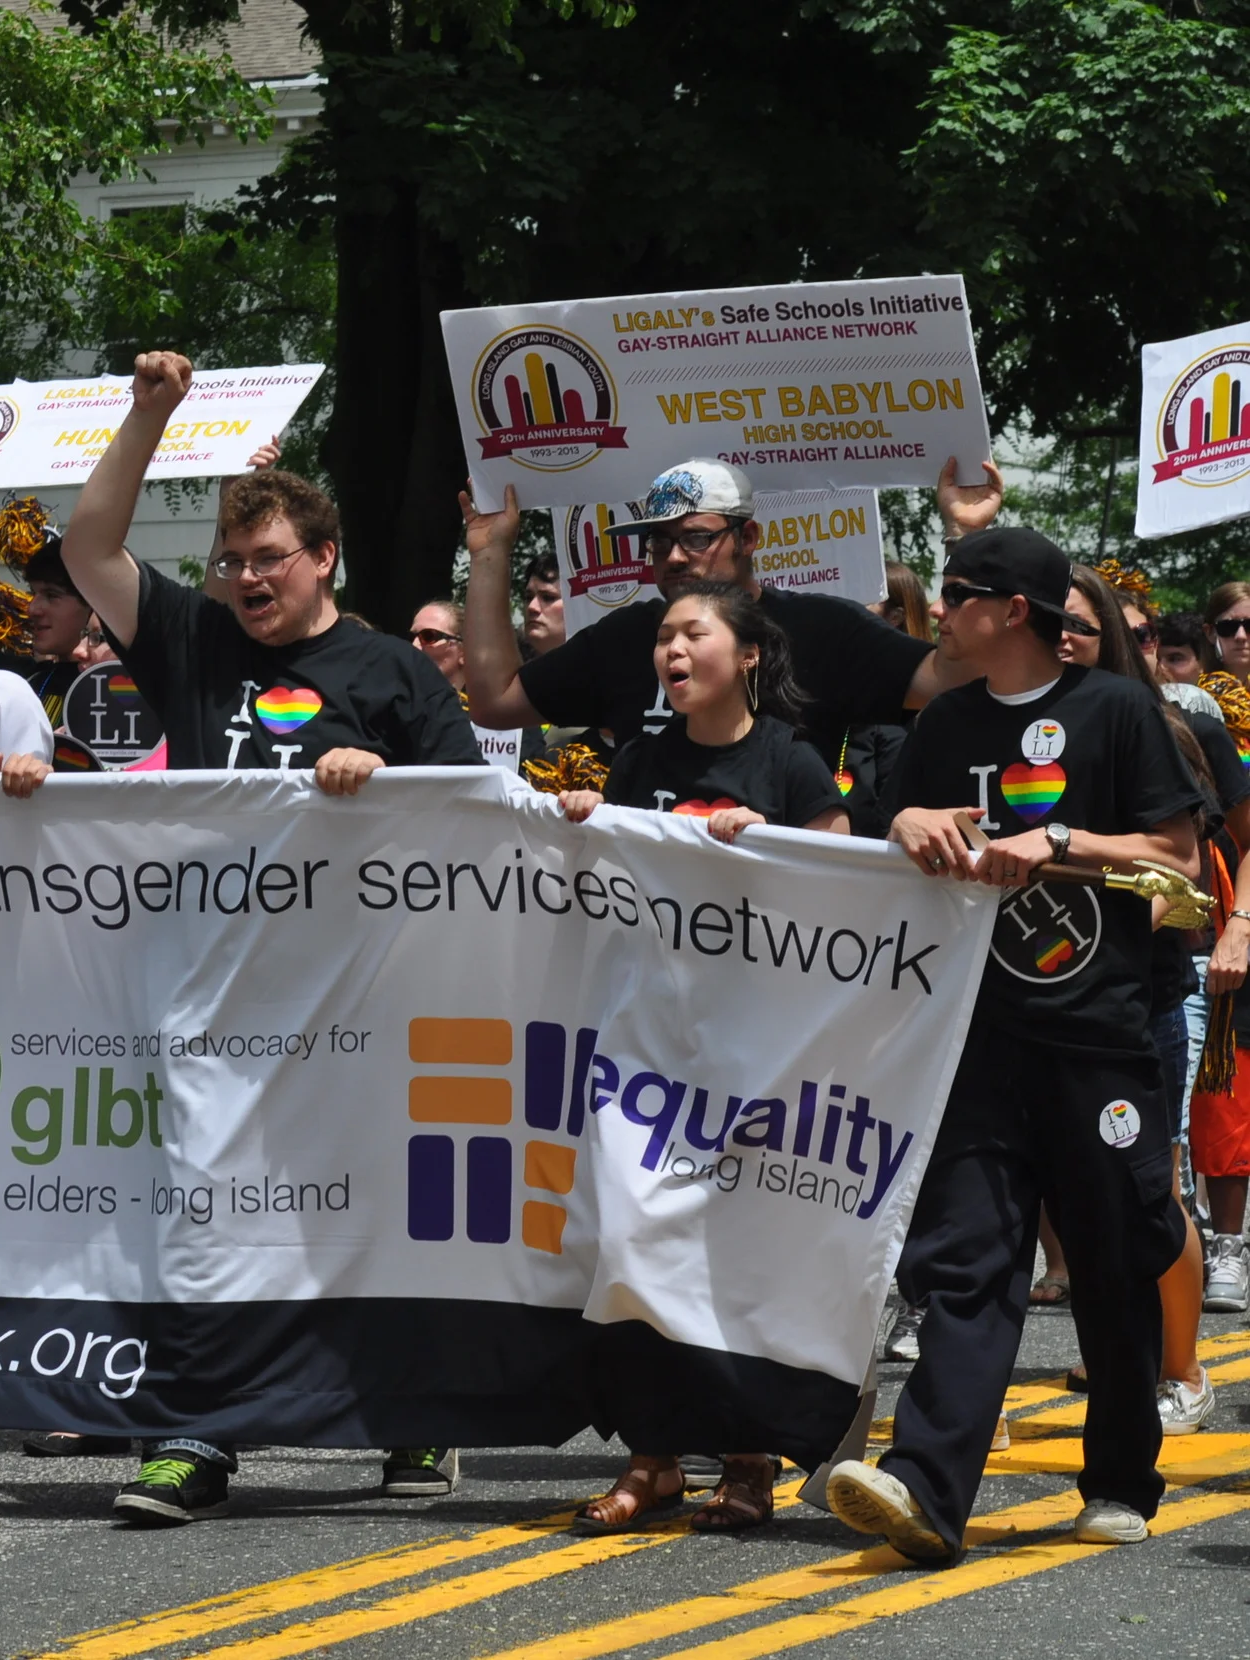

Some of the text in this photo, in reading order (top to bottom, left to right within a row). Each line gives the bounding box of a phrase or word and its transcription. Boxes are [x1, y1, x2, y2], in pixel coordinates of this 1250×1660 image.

[613, 293, 964, 333] LIGALY's Safe Schools Initiative
[618, 321, 918, 354] GAY-STRAIGHT ALLIANCE NETWORK
[482, 334, 605, 400] LONG ISLAND GAY AND LESBIAN YOUTH
[37, 397, 130, 411] GAY-STRAIGHT
[196, 389, 266, 401] NETWORK
[44, 385, 121, 400] LIGALY's
[190, 379, 234, 390] hools
[239, 373, 314, 387] Initiative
[1166, 397, 1182, 426] LONG
[1177, 366, 1204, 400] ISLAND
[1202, 355, 1222, 373] GAY
[1222, 351, 1242, 363] AND
[656, 378, 965, 425] WEST BABYLON
[53, 420, 251, 447] HUNGTON
[527, 427, 605, 440] ANNIVERSARY
[743, 420, 893, 445] HIGH SCHOOL
[149, 452, 214, 463] ALLIANCE
[530, 446, 580, 458] 1993-2013
[843, 443, 926, 461] ALLIANCE
[1199, 436, 1250, 459] ANNIVERS
[1199, 457, 1246, 476] 1993-2013
[597, 565, 644, 579] ANNIVERSARY
[761, 548, 820, 573] SCHOOL
[788, 567, 840, 587] ALLIANCE
[89, 674, 108, 708] I
[89, 711, 141, 745] LI
[1033, 724, 1041, 739] I
[1031, 741, 1053, 756] LI
[969, 764, 1000, 831] I
[358, 848, 639, 927] services
[645, 896, 940, 996] network
[11, 1024, 372, 1060] services and advocacy for
[10, 1066, 164, 1165] glbt
[589, 1052, 915, 1220] equality
[1110, 1120, 1133, 1141] LI
[756, 1150, 865, 1216] island
[3, 1175, 118, 1215] elders
[151, 1176, 215, 1225] long
[230, 1172, 350, 1214] island
